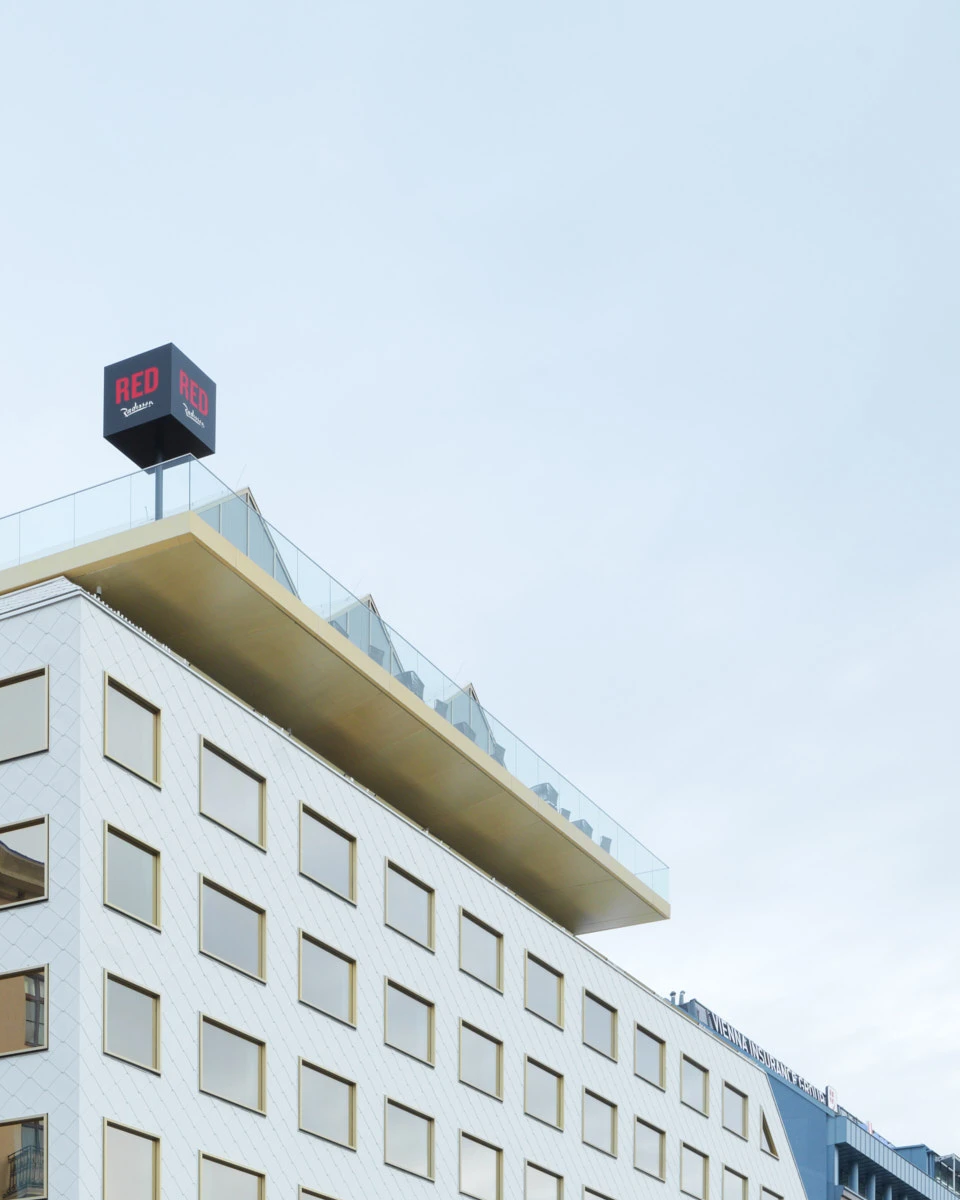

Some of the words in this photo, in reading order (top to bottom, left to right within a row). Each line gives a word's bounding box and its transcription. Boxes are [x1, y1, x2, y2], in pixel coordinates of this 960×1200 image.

[115, 366, 159, 405] RED
[179, 368, 209, 417] RED
[711, 1011, 748, 1053] VIENNA
